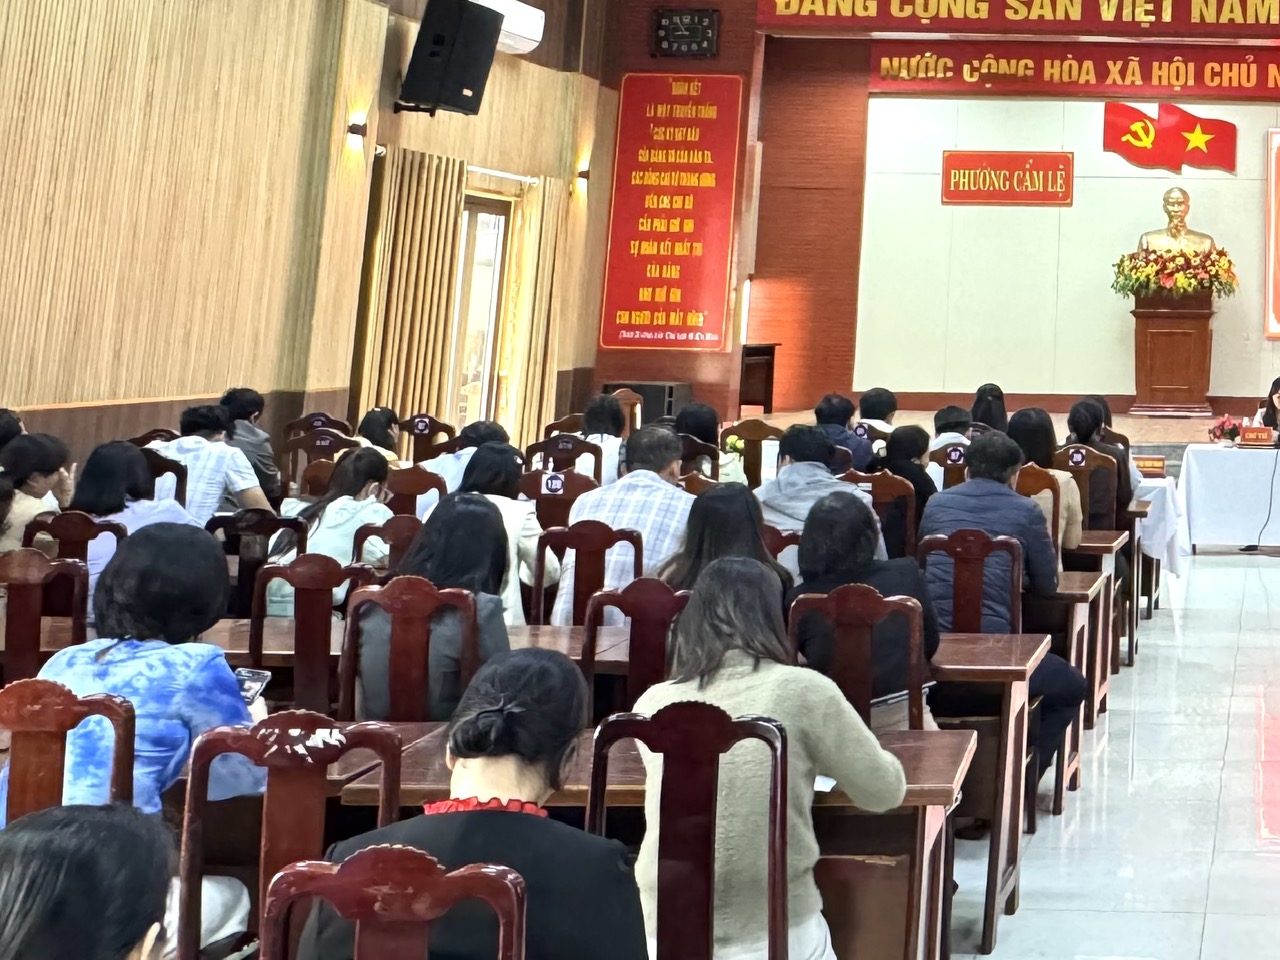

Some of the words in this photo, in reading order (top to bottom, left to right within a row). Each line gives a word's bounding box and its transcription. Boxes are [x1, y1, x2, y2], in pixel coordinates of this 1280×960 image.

[880, 51, 953, 80] NƯỚC
[1043, 54, 1097, 85] HÒA
[1106, 56, 1143, 85] XÃ
[1151, 56, 1195, 91] HỘI
[1204, 54, 1257, 87] CHỦ
